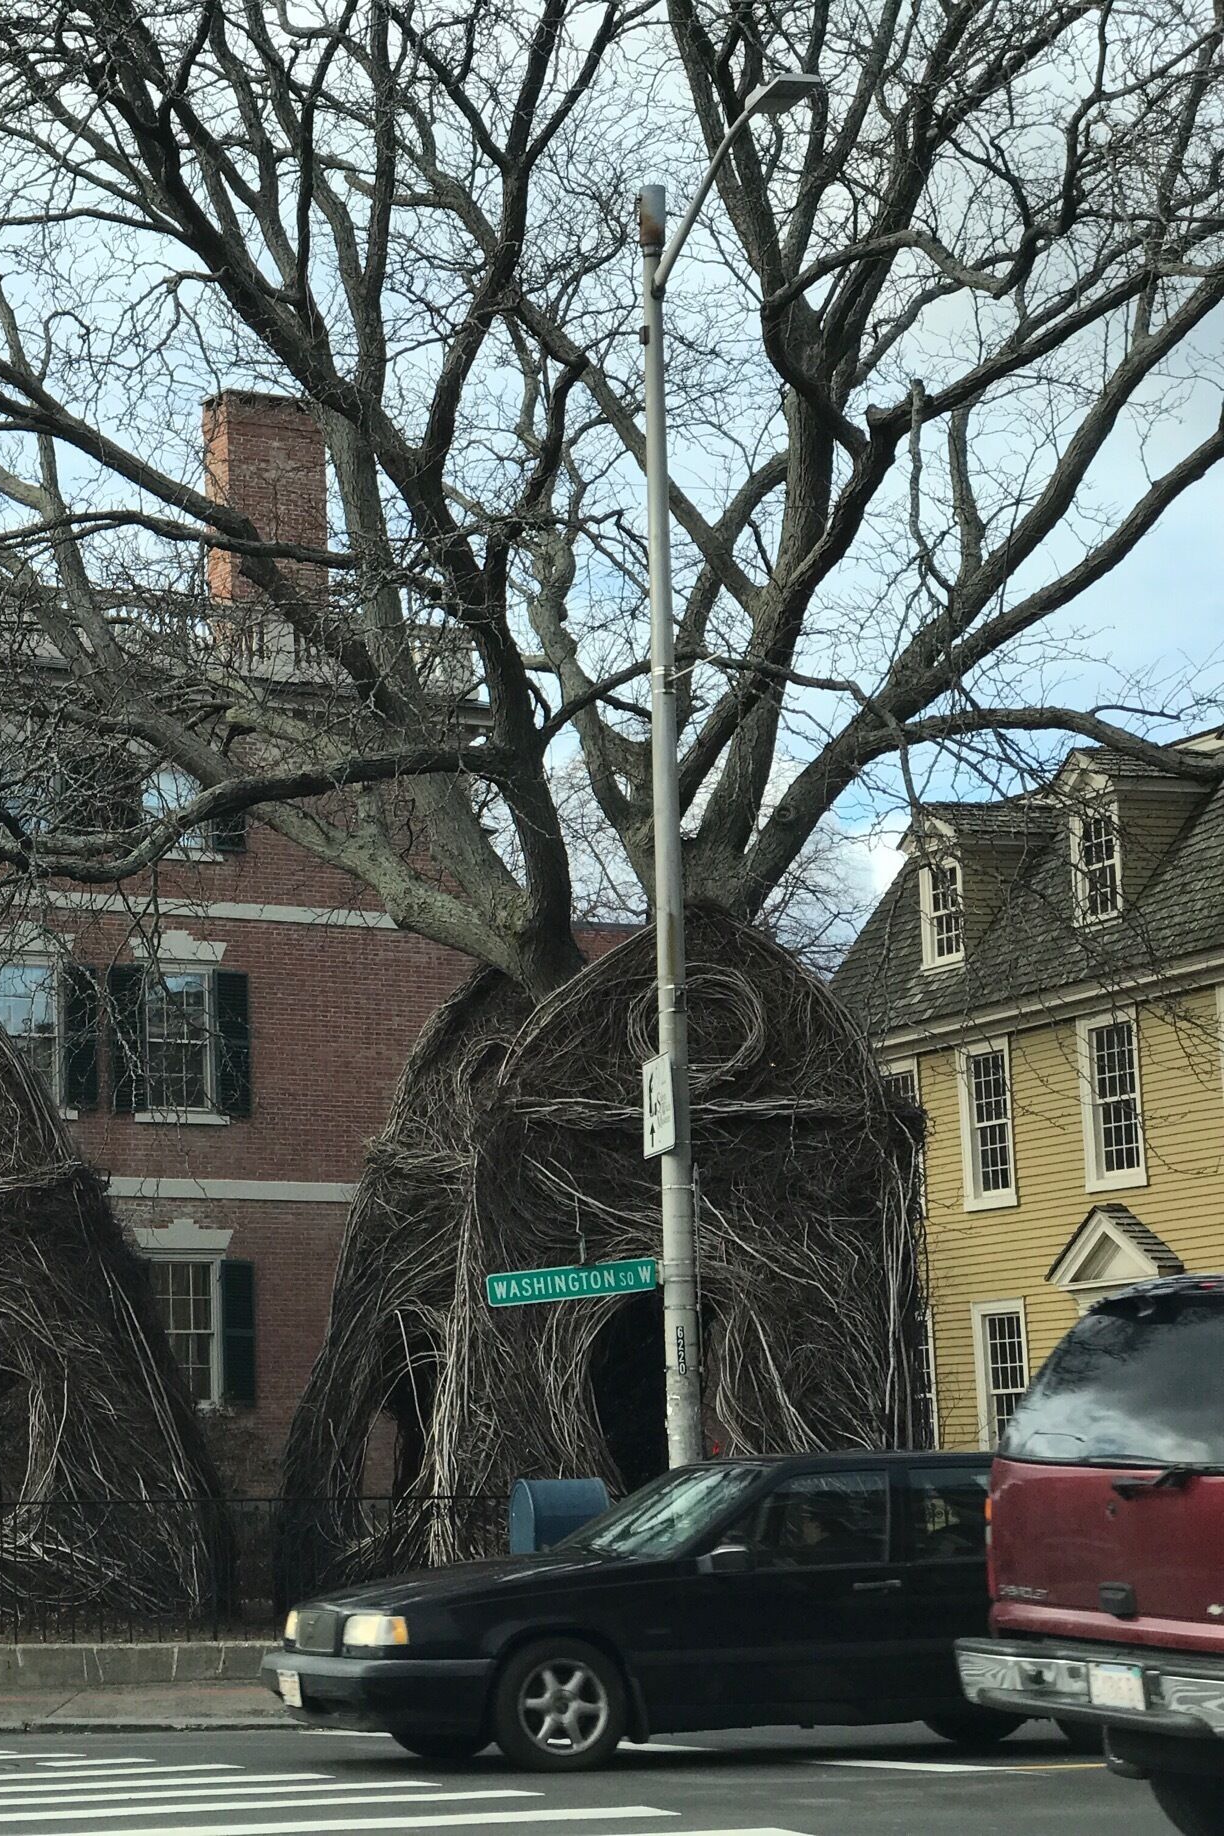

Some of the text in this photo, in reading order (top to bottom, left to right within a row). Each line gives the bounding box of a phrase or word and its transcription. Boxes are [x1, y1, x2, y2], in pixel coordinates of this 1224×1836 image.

[493, 1265, 651, 1300] WASHINGTON SQ W
[677, 1326, 686, 1375] 6220
